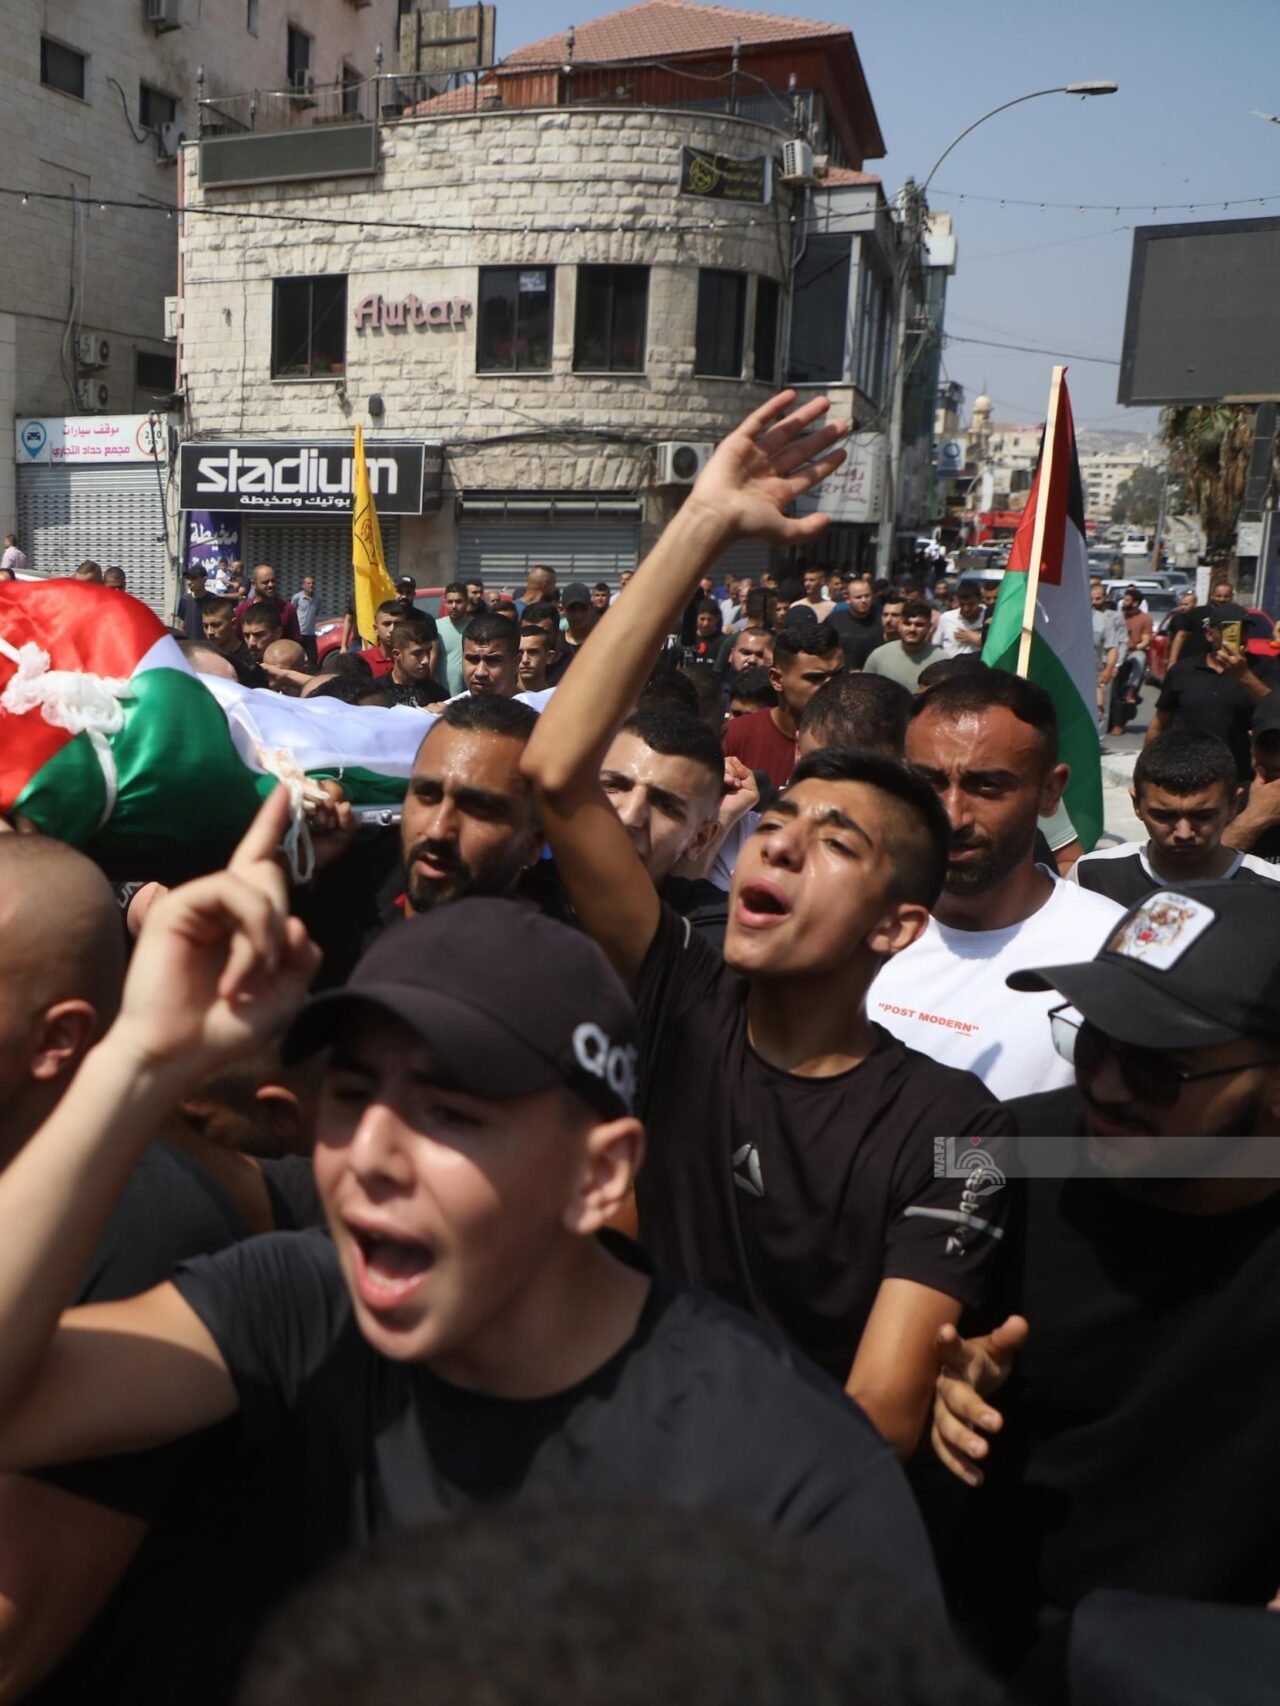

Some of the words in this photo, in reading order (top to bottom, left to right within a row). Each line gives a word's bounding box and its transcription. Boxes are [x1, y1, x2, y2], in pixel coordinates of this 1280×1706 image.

[355, 294, 472, 329] Autar
[63, 424, 91, 437] سيارات
[94, 423, 120, 437] موقف
[145, 430, 162, 439] 20
[52, 446, 81, 458] التجاري
[82, 446, 102, 455] حداد
[105, 446, 130, 458] مجمع
[197, 449, 398, 494] stadium
[240, 494, 303, 507] ومخيطة
[306, 495, 351, 508] بوتيك
[191, 522, 238, 551] مخيطة
